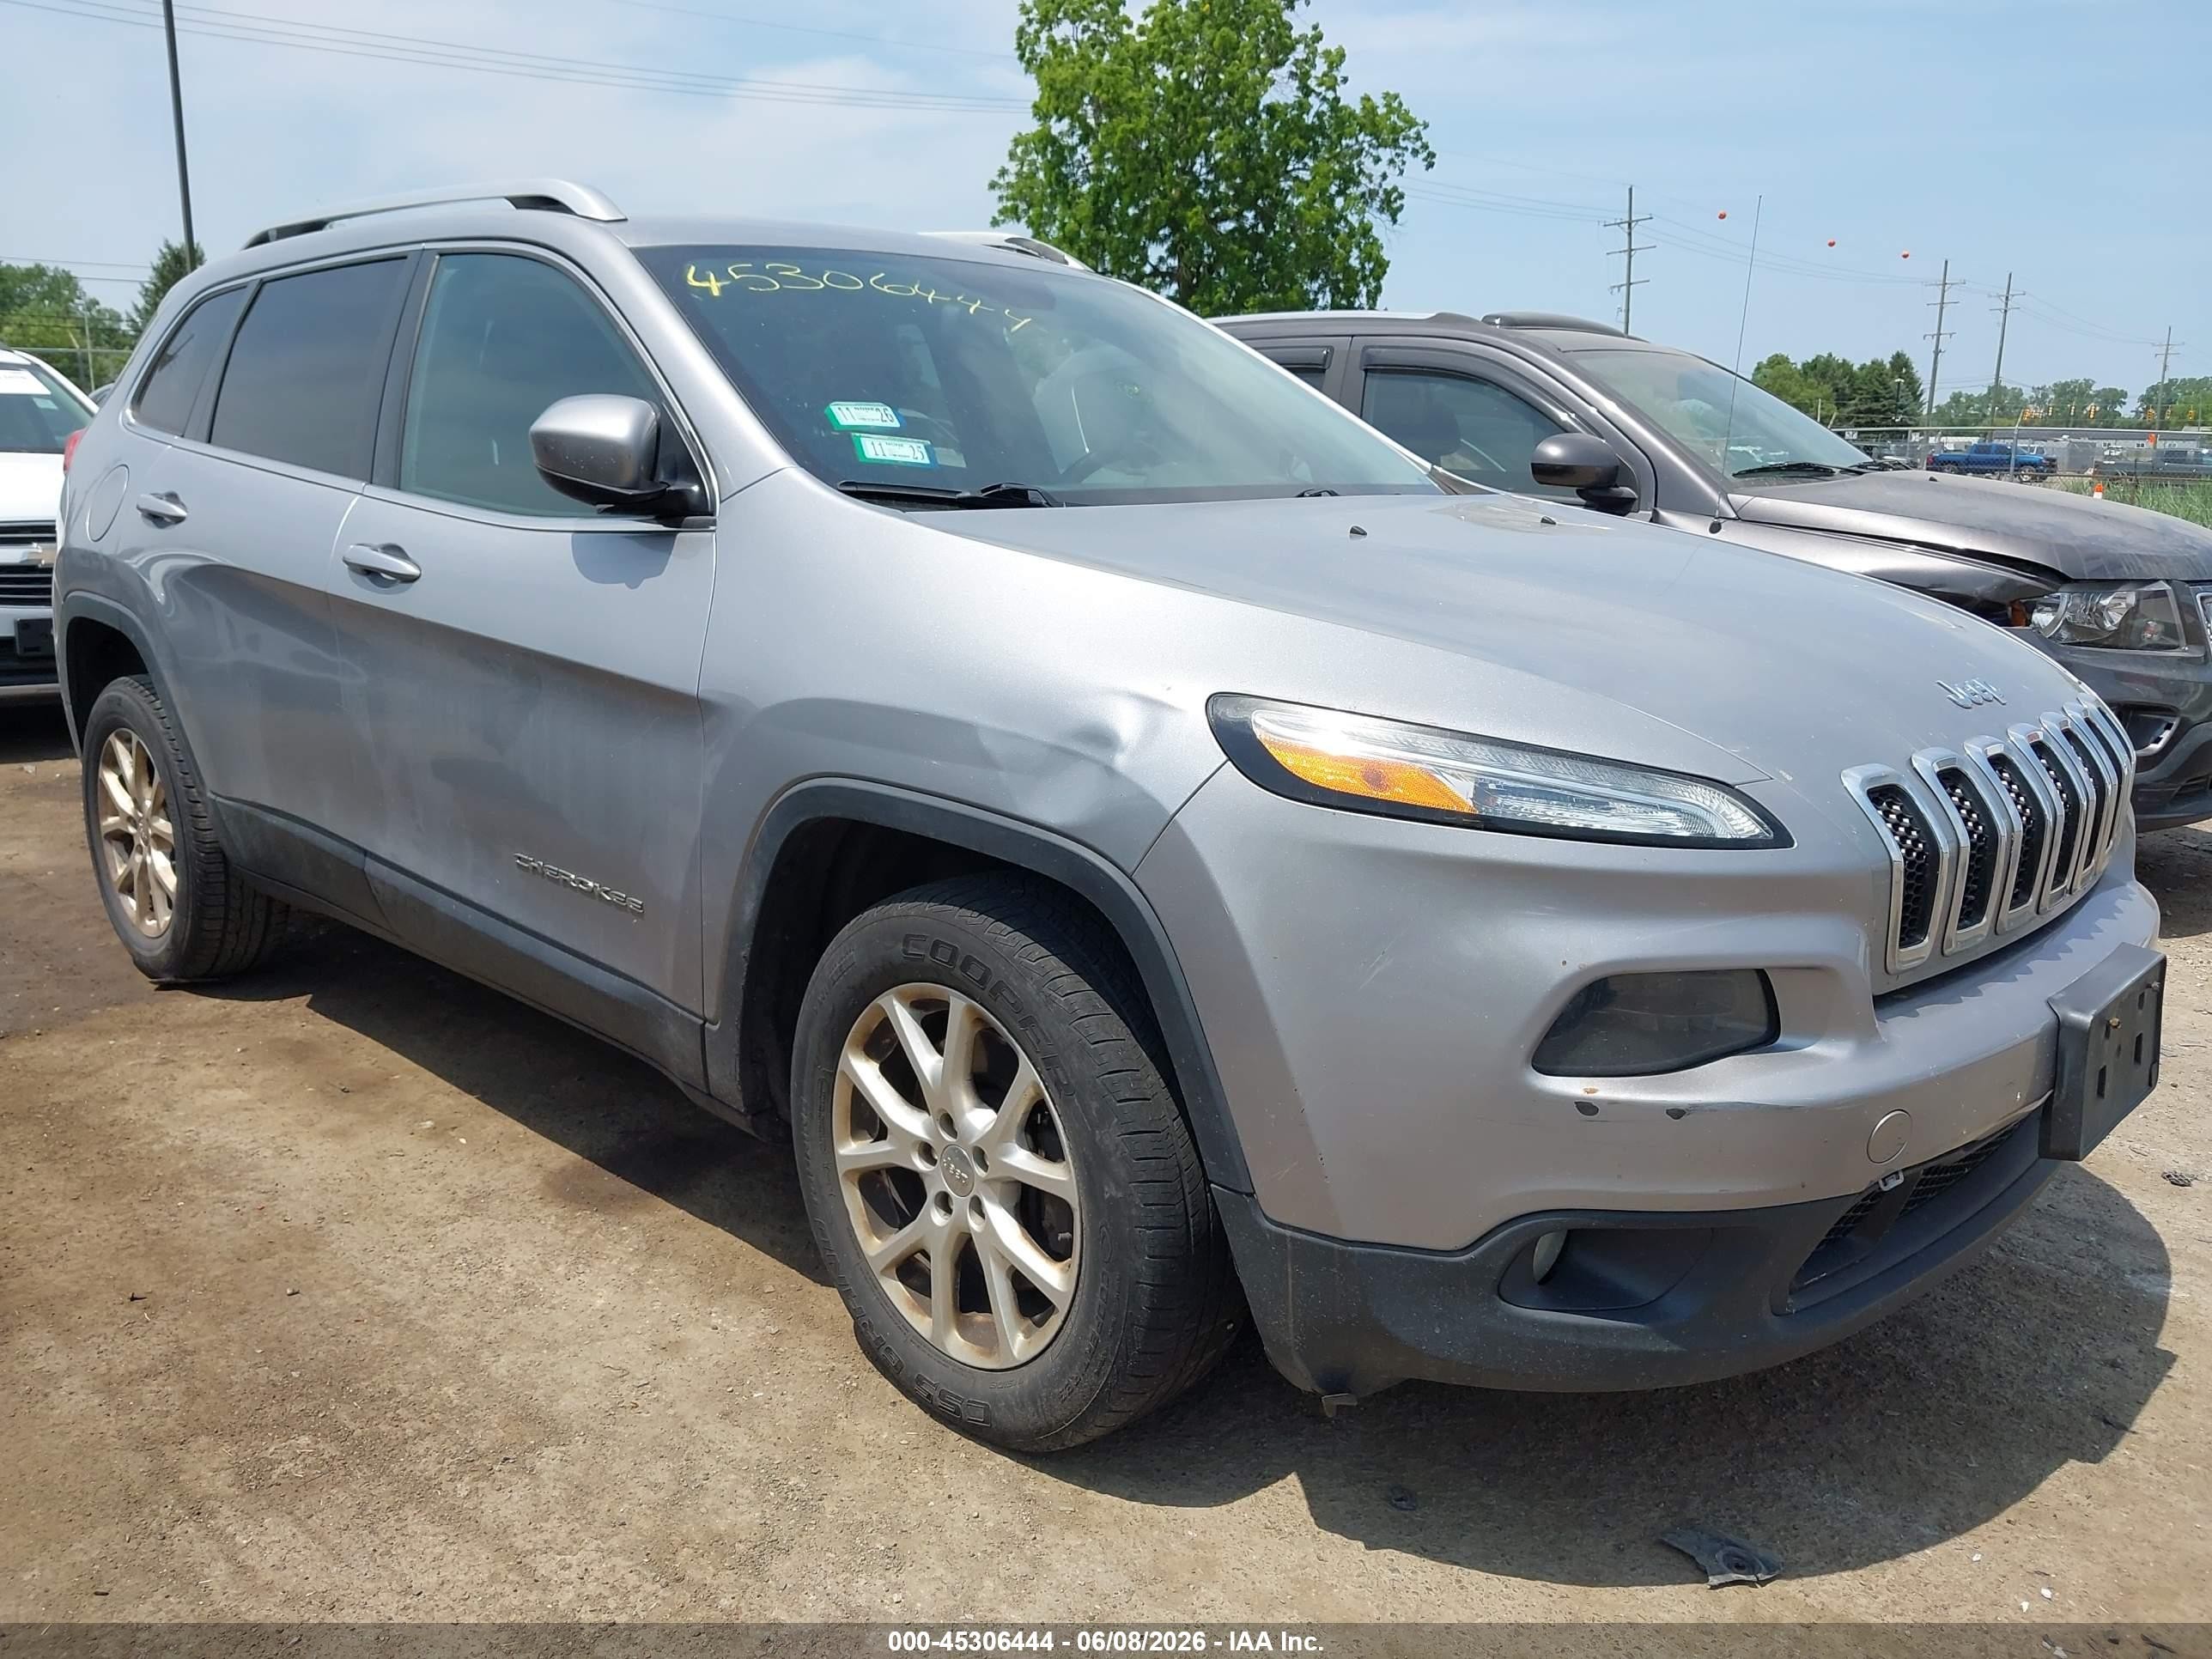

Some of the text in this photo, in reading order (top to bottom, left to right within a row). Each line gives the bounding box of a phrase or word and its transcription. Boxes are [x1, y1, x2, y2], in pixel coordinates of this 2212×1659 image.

[875, 406, 895, 423] 26
[908, 444, 925, 461] 25
[1936, 678, 2008, 709] Jeep
[513, 852, 645, 914] CHEROKEE
[902, 933, 1077, 1098] COOPER
